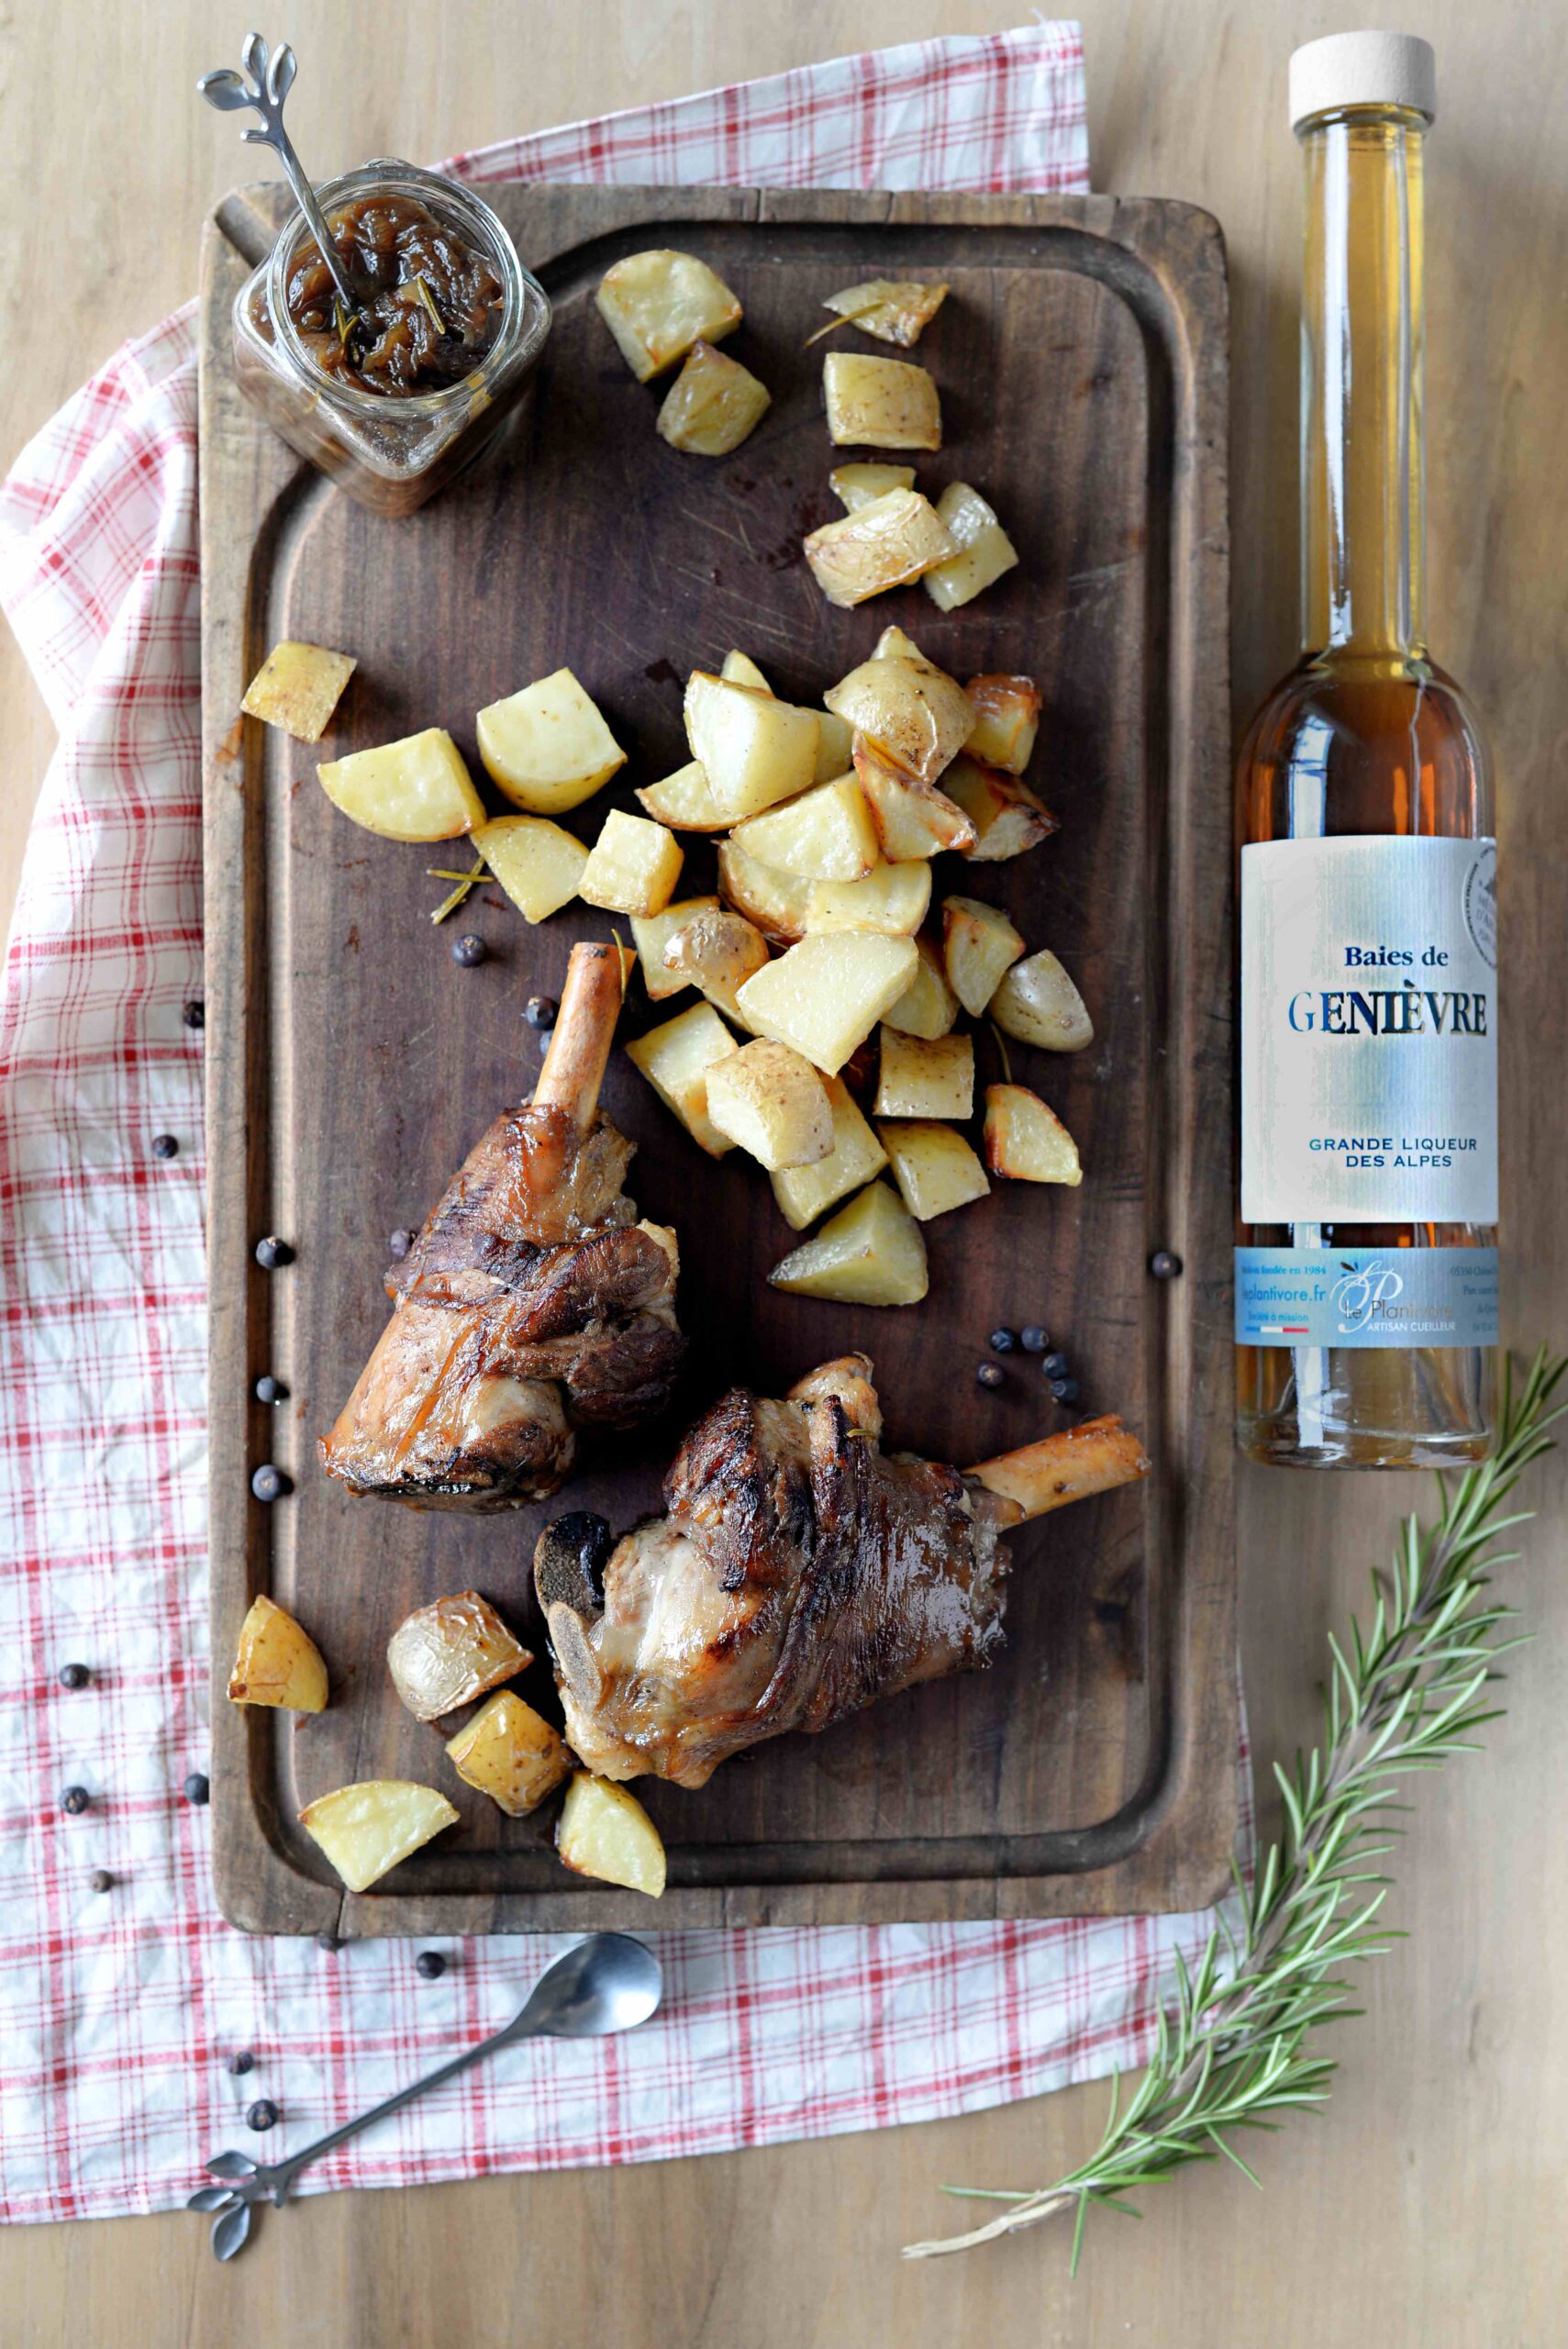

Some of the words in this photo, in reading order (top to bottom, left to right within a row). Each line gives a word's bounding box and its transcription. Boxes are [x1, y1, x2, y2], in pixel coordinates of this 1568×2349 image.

[1344, 946, 1414, 967] Baies
[1421, 946, 1449, 966] de
[1288, 979, 1487, 1036] GENIÈVRE
[1309, 1138, 1393, 1151] GRANDE
[1402, 1138, 1477, 1152] LIQUEUR
[1346, 1155, 1385, 1167] DES
[1394, 1155, 1452, 1167] ALPES
[1304, 1265, 1327, 1275] 1984
[1278, 1313, 1308, 1322] mission
[1366, 1322, 1407, 1331] ARTISAN
[1410, 1321, 1456, 1331] CUEILLEUR
